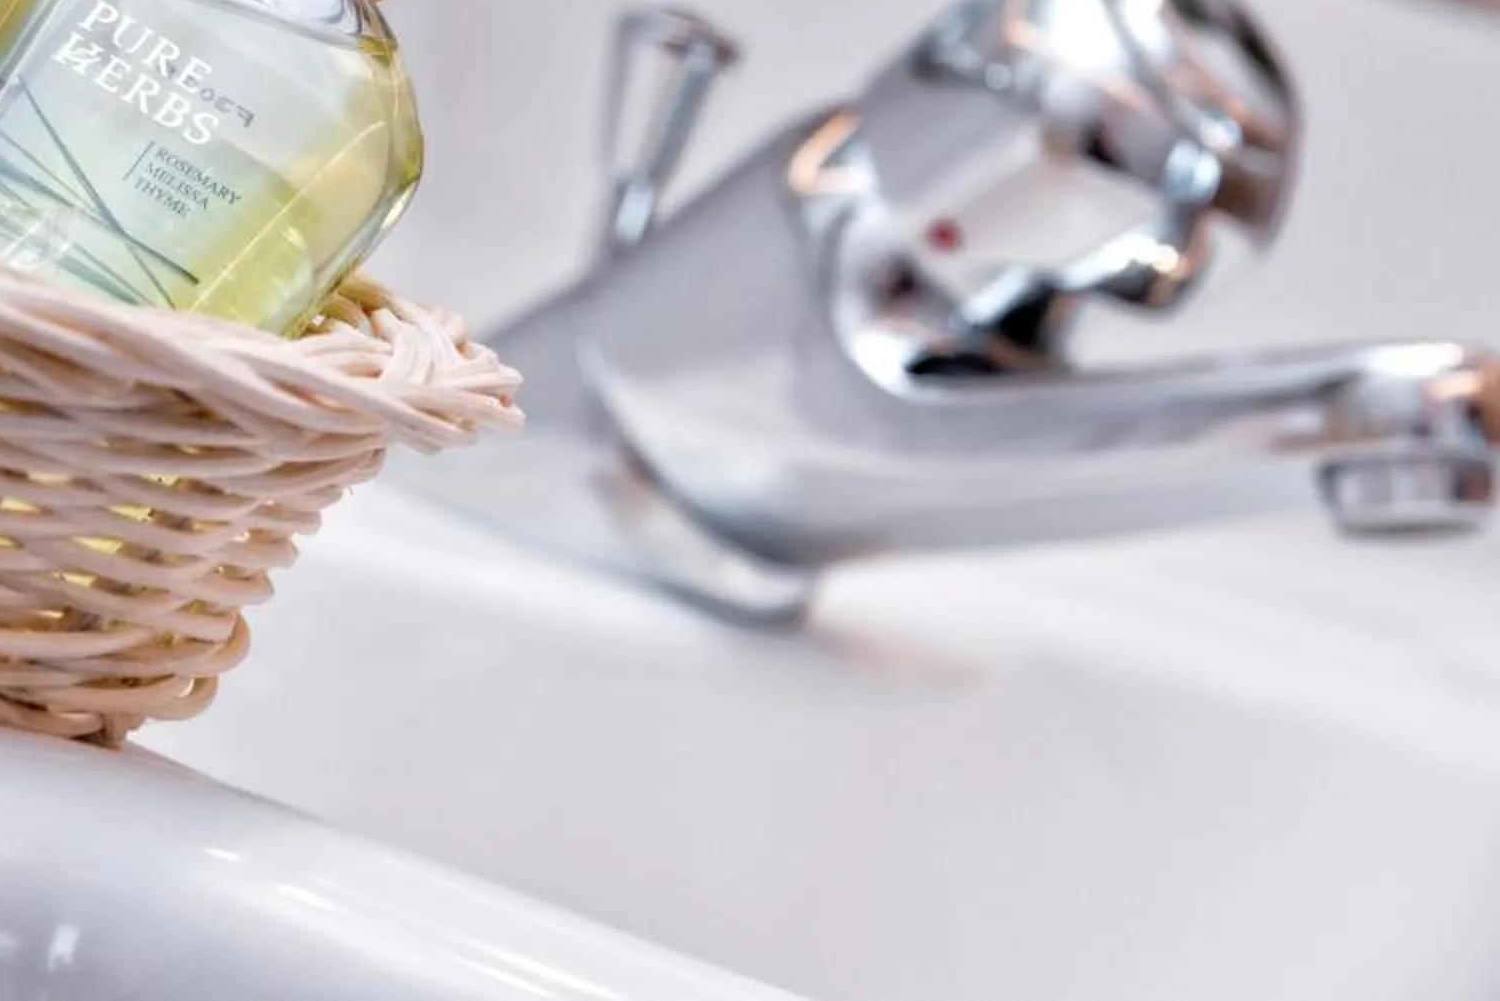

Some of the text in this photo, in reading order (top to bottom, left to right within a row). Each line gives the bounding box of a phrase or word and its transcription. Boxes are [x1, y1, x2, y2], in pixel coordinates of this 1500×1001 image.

[52, 30, 220, 146] HERBS
[134, 176, 192, 218] THYME
[146, 162, 209, 211] MELISSA
[154, 147, 243, 205] ROSEMARY
